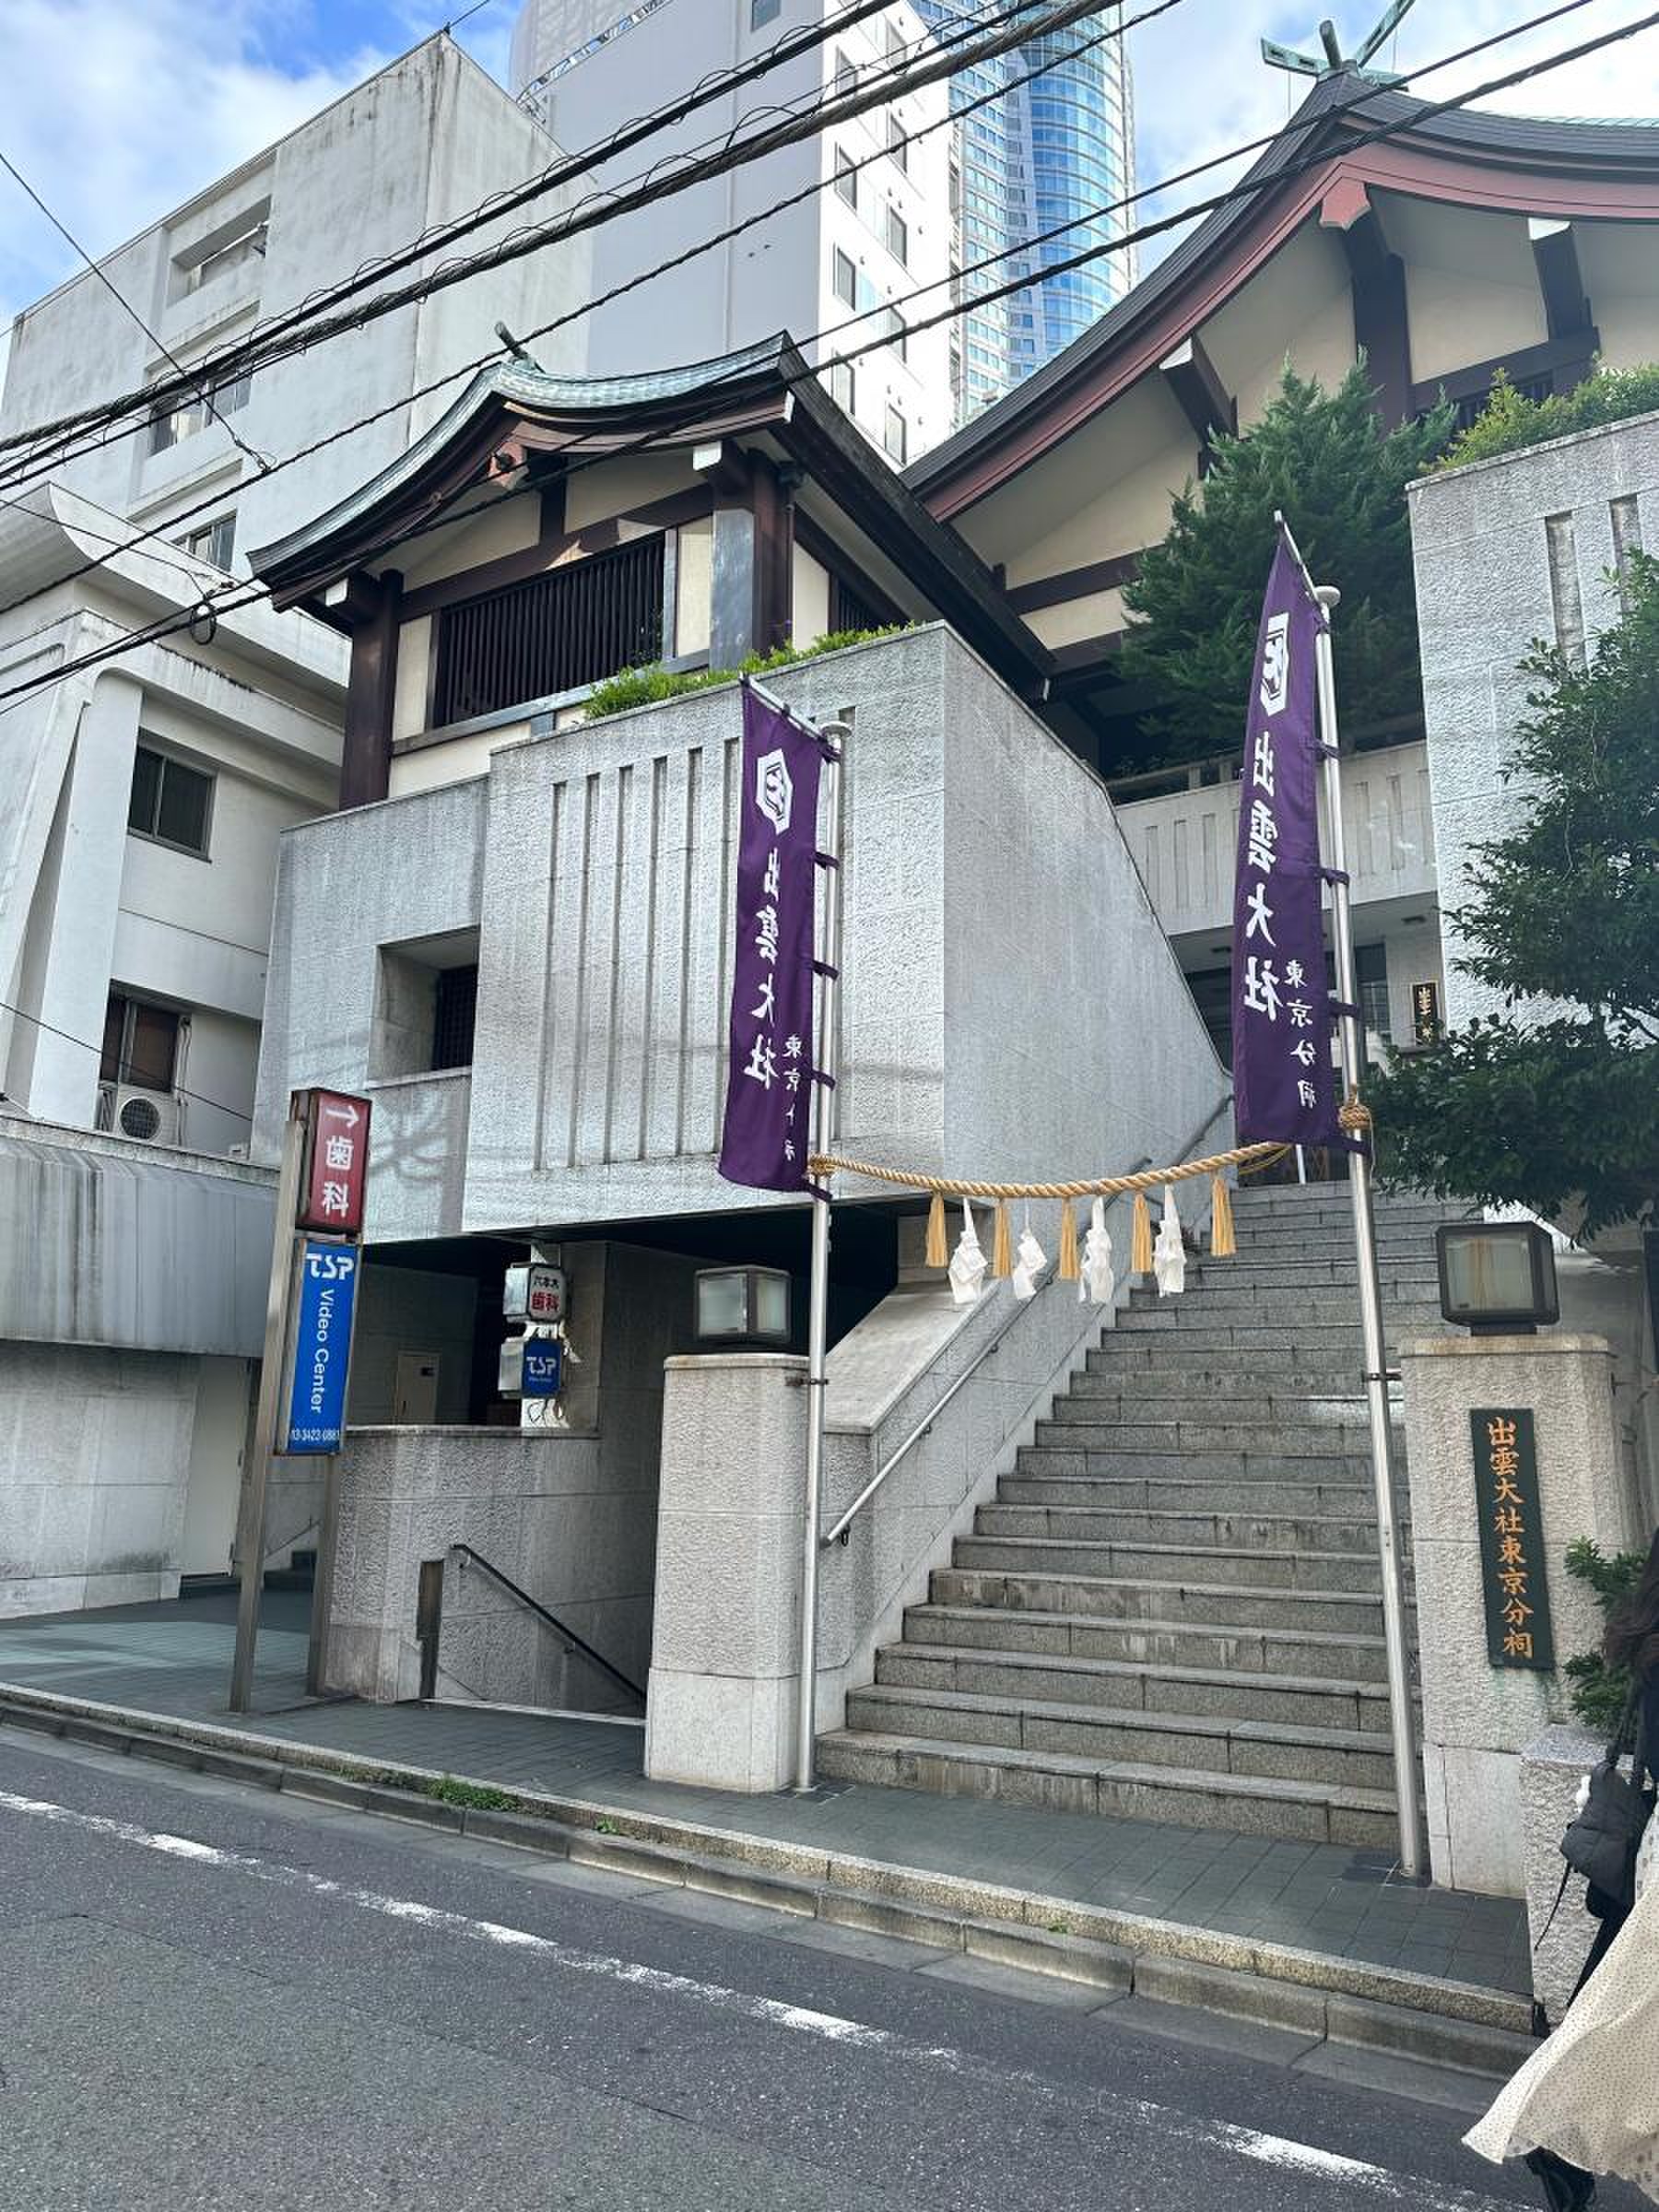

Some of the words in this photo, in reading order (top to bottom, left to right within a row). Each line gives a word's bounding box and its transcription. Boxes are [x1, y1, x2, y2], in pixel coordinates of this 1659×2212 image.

[321, 1135, 355, 1218] 歯科
[305, 1253, 355, 1281] TSP
[315, 1288, 335, 1343] Video
[530, 1291, 560, 1312] 歯科
[310, 1347, 330, 1415] Center
[525, 1356, 557, 1376] TSP
[1487, 1415, 1535, 1659] 出雲大社東京分祠
